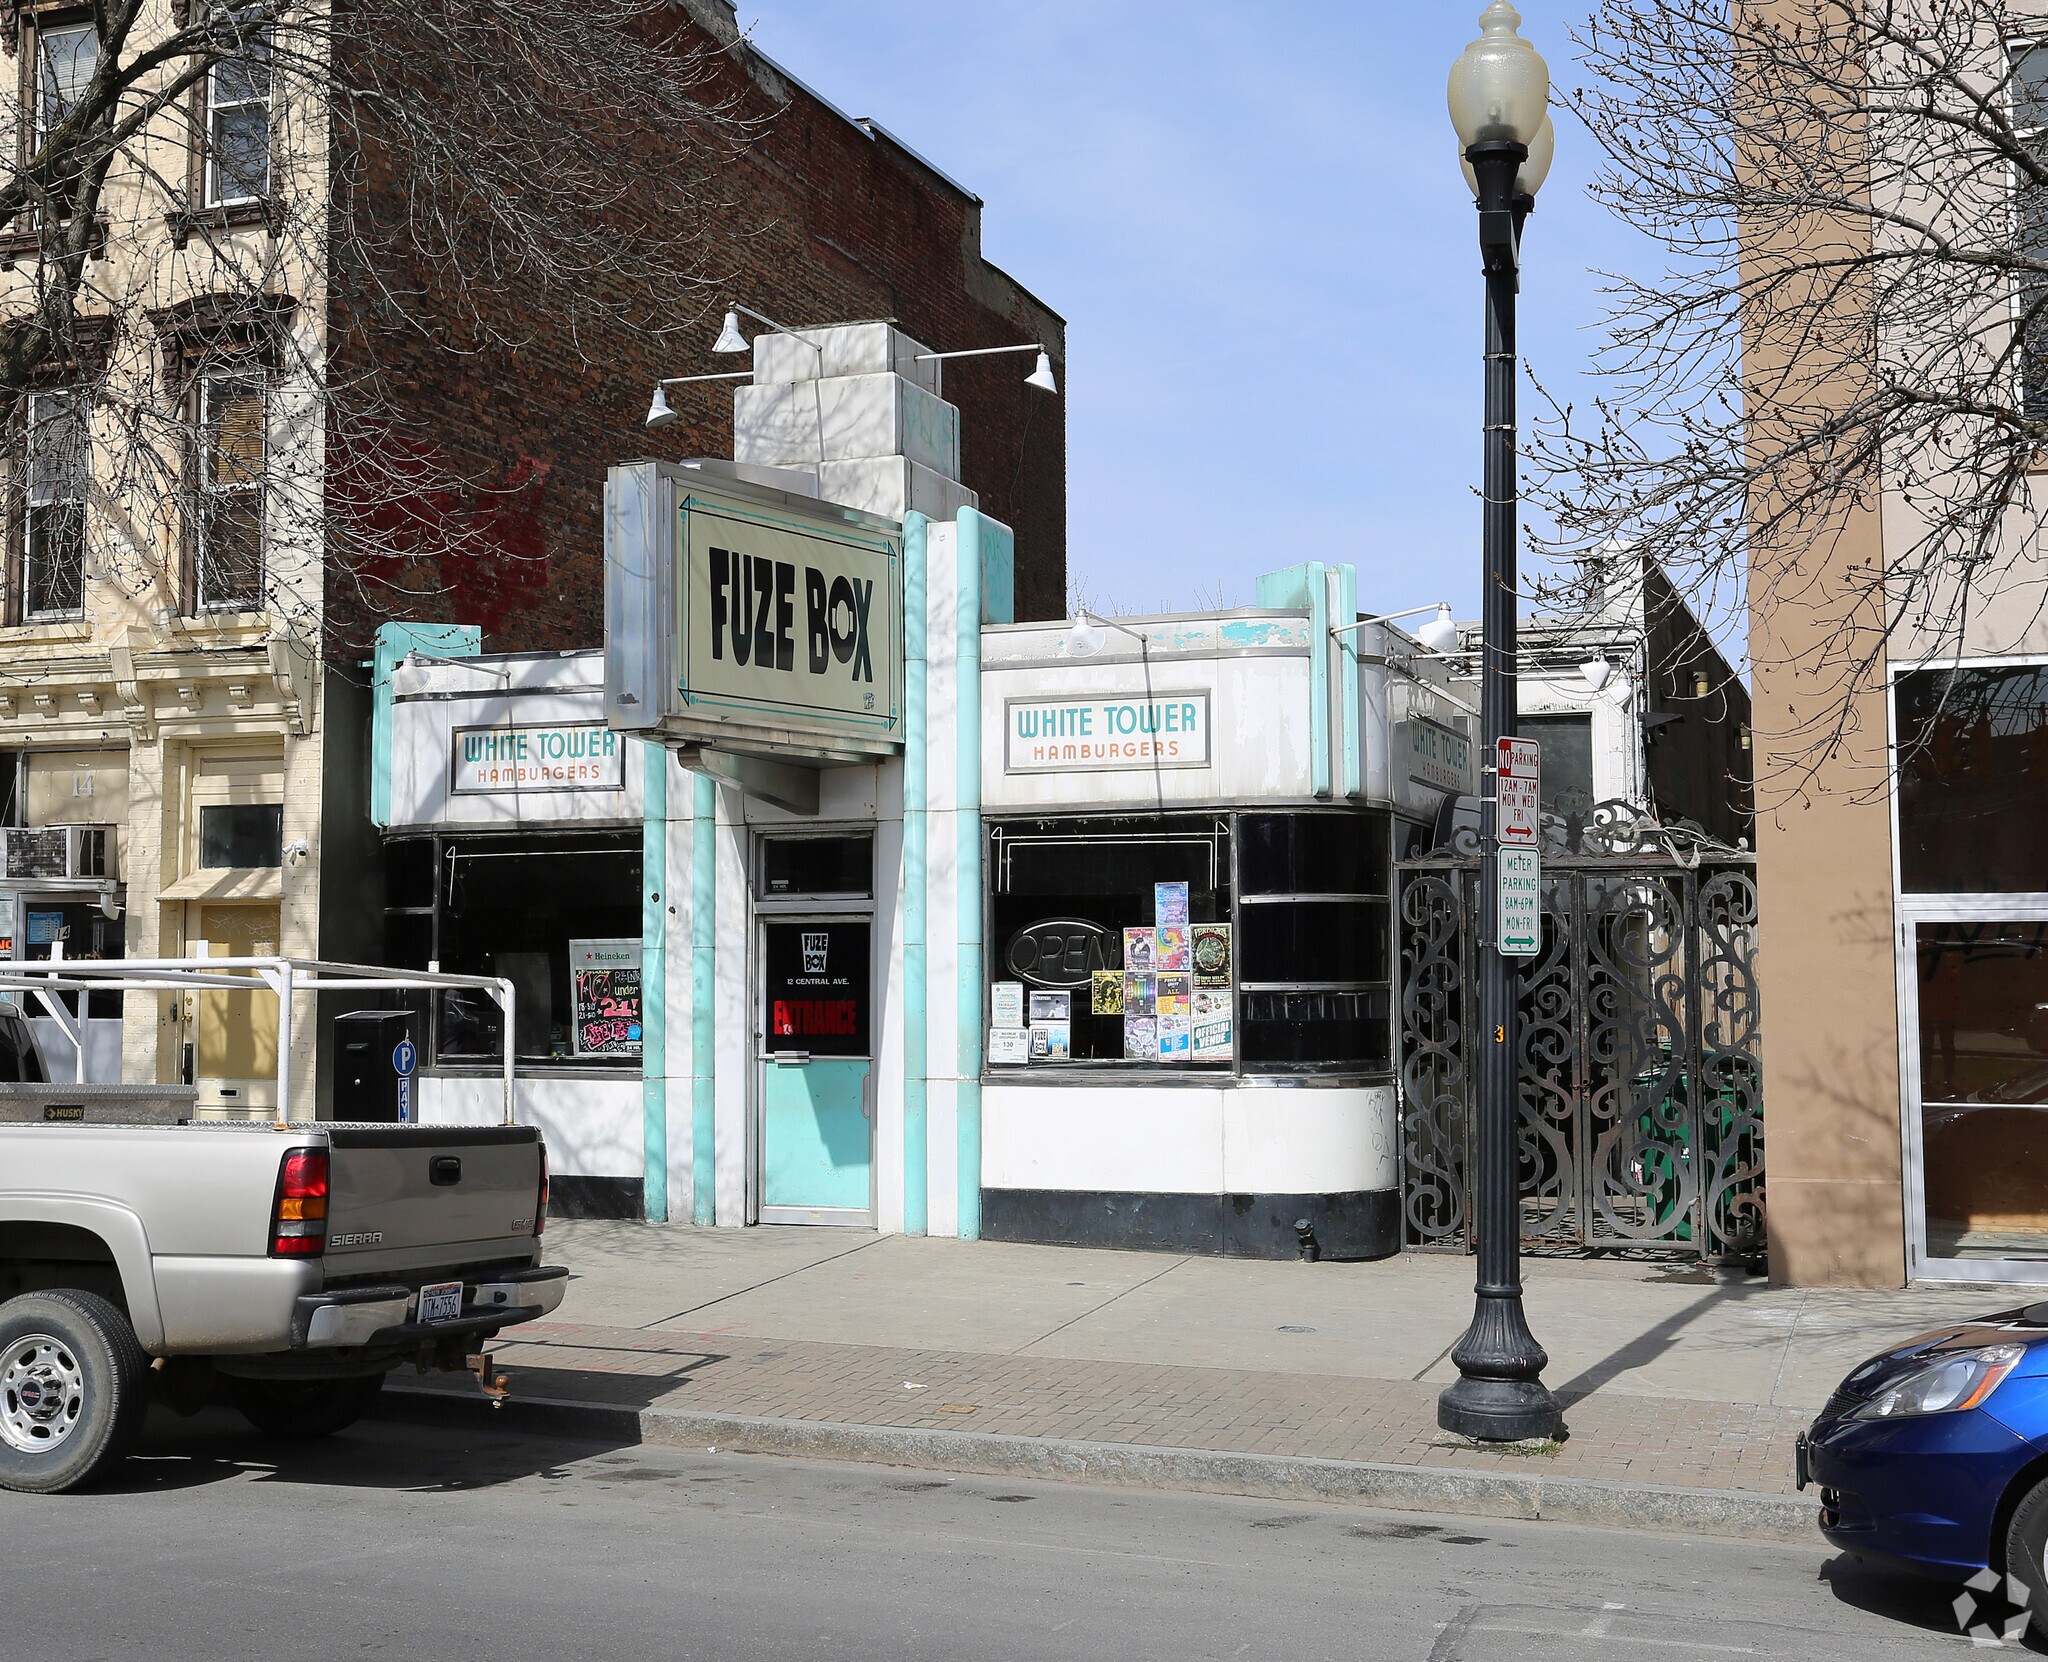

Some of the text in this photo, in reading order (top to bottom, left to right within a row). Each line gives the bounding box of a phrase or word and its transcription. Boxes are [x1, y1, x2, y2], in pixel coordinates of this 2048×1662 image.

[709, 546, 873, 683] FUZE BOX
[1018, 703, 1196, 739] WHITE TOWER
[465, 730, 615, 763] WHITE TOWER
[1034, 740, 1179, 761] HAMBURGERS
[1412, 721, 1467, 771] WHITE TOWER
[1499, 749, 1538, 769] NO PARKING
[478, 764, 600, 783] HAMBURGERS
[71, 772, 95, 797] 14
[1502, 793, 1535, 808] MON WED
[1513, 808, 1524, 822] FRI
[1507, 857, 1532, 871] METER
[1503, 876, 1536, 891] PARKING
[1505, 896, 1534, 911] 8AM-6PM
[1506, 916, 1533, 930] MON-FRI
[57, 926, 70, 940] 14
[804, 934, 828, 952] FUZE
[594, 952, 631, 960] Heineken
[805, 954, 826, 971] BOX
[1010, 935, 1116, 973] OPEN
[614, 986, 639, 996] under
[600, 997, 639, 1017] 21!
[774, 1000, 857, 1035] ENTRANCE
[1195, 1020, 1230, 1039] OFFICIAL
[1199, 1032, 1226, 1048] VENUE
[402, 1047, 411, 1070] P
[56, 1108, 84, 1118] HUSKY
[512, 1218, 534, 1231] GMC
[330, 1231, 383, 1247] SIERRA
